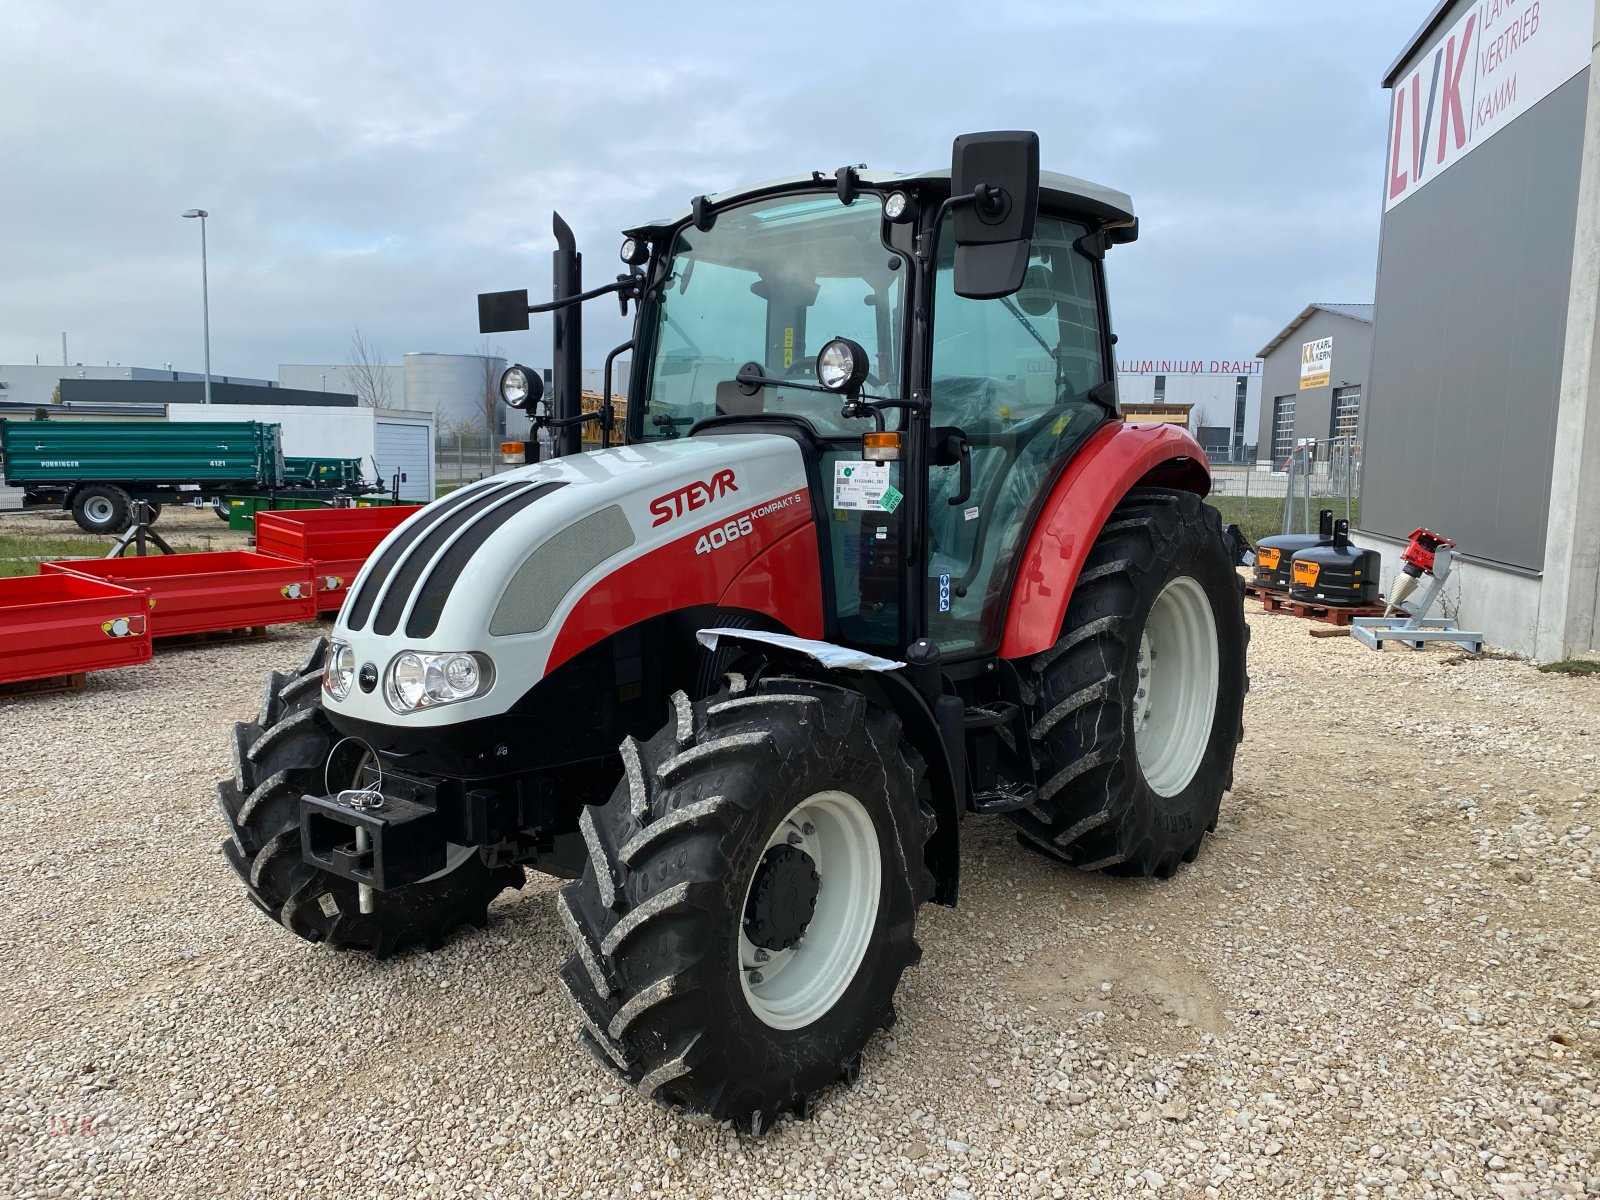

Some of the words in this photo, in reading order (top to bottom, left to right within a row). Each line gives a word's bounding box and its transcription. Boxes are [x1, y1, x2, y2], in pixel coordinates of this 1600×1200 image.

[1485, 0, 1515, 30] LA
[1481, 1, 1540, 78] VERTRIEB
[1390, 13, 1476, 200] LVK
[1476, 72, 1517, 130] KAMM
[1210, 361, 1263, 373] DRAHT
[1302, 343, 1316, 364] KK
[1316, 340, 1331, 350] KARL
[1316, 351, 1331, 361] KERN
[649, 468, 739, 528] STEYR
[695, 516, 753, 556] 4065
[751, 497, 793, 520] KOMPAKT
[794, 493, 801, 503] S
